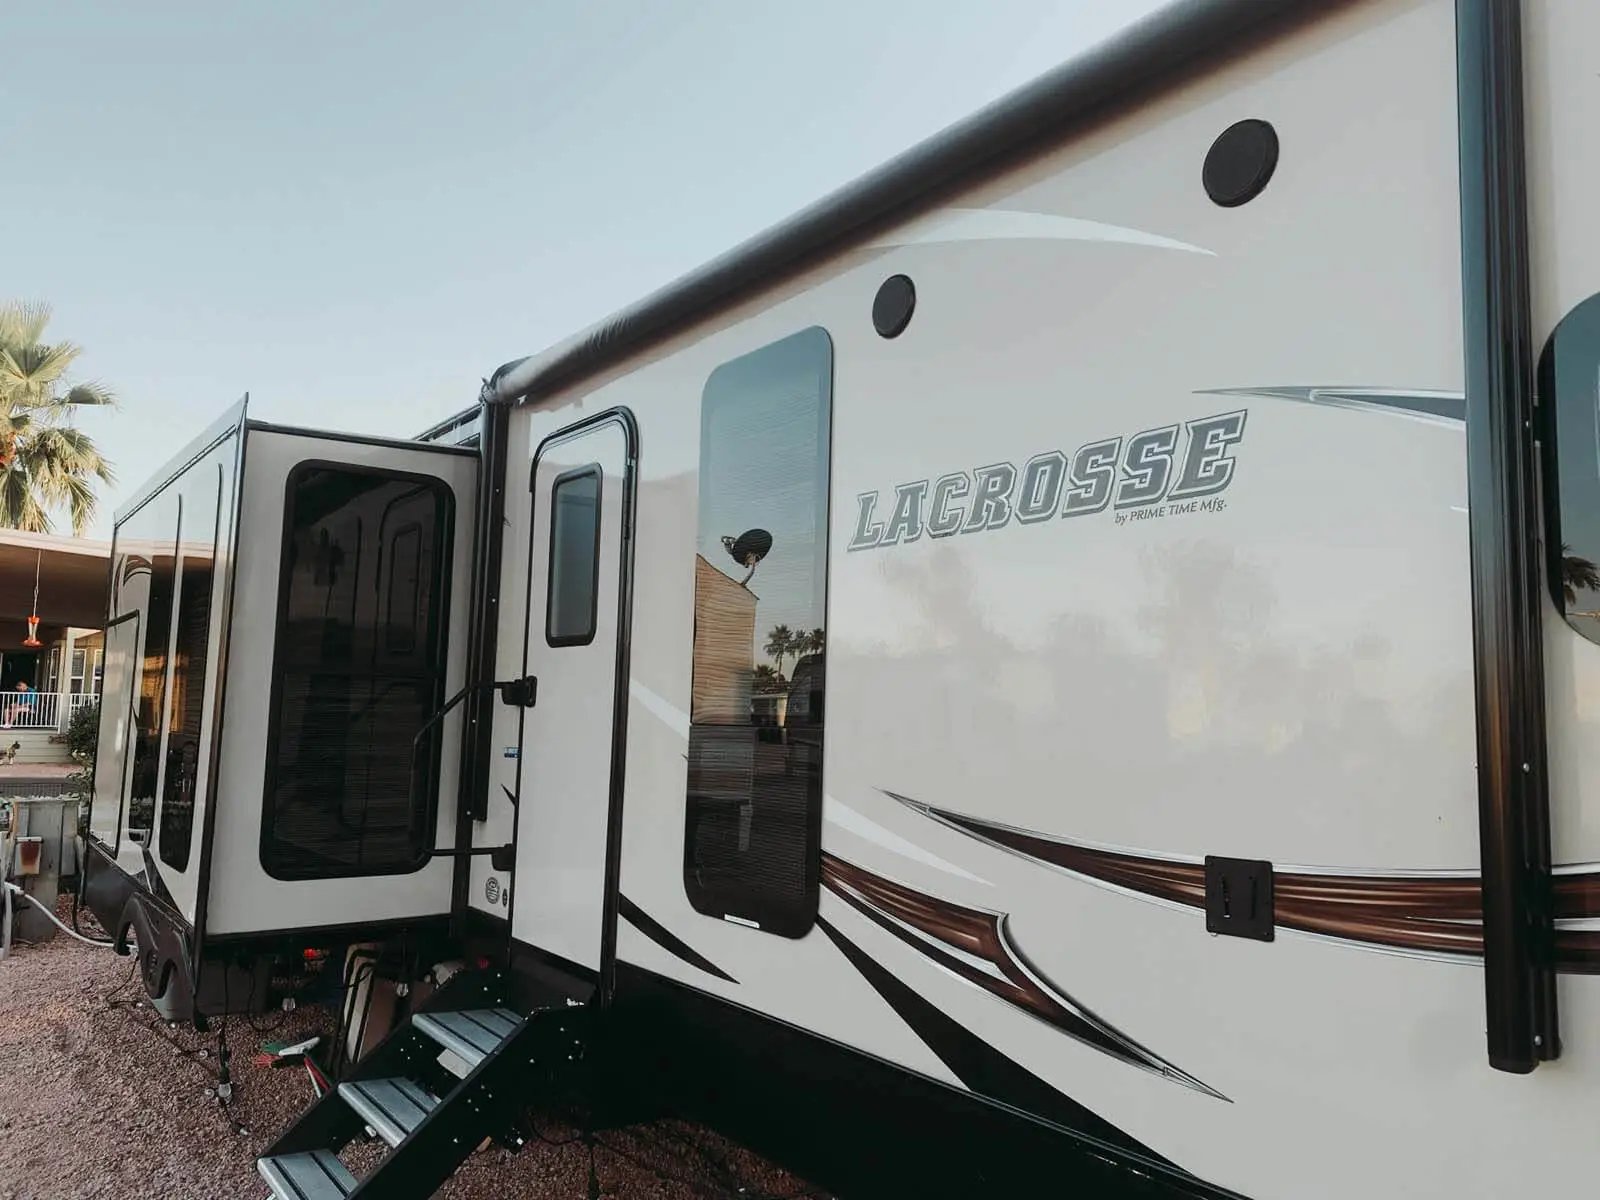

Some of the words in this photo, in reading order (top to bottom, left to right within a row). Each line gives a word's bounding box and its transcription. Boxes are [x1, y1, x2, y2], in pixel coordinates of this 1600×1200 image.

[847, 409, 1248, 552] LACROSSE
[1114, 512, 1128, 526] by
[1130, 506, 1166, 521] PRIME
[1168, 501, 1198, 516] TIME
[1200, 497, 1228, 514] Mfg.
